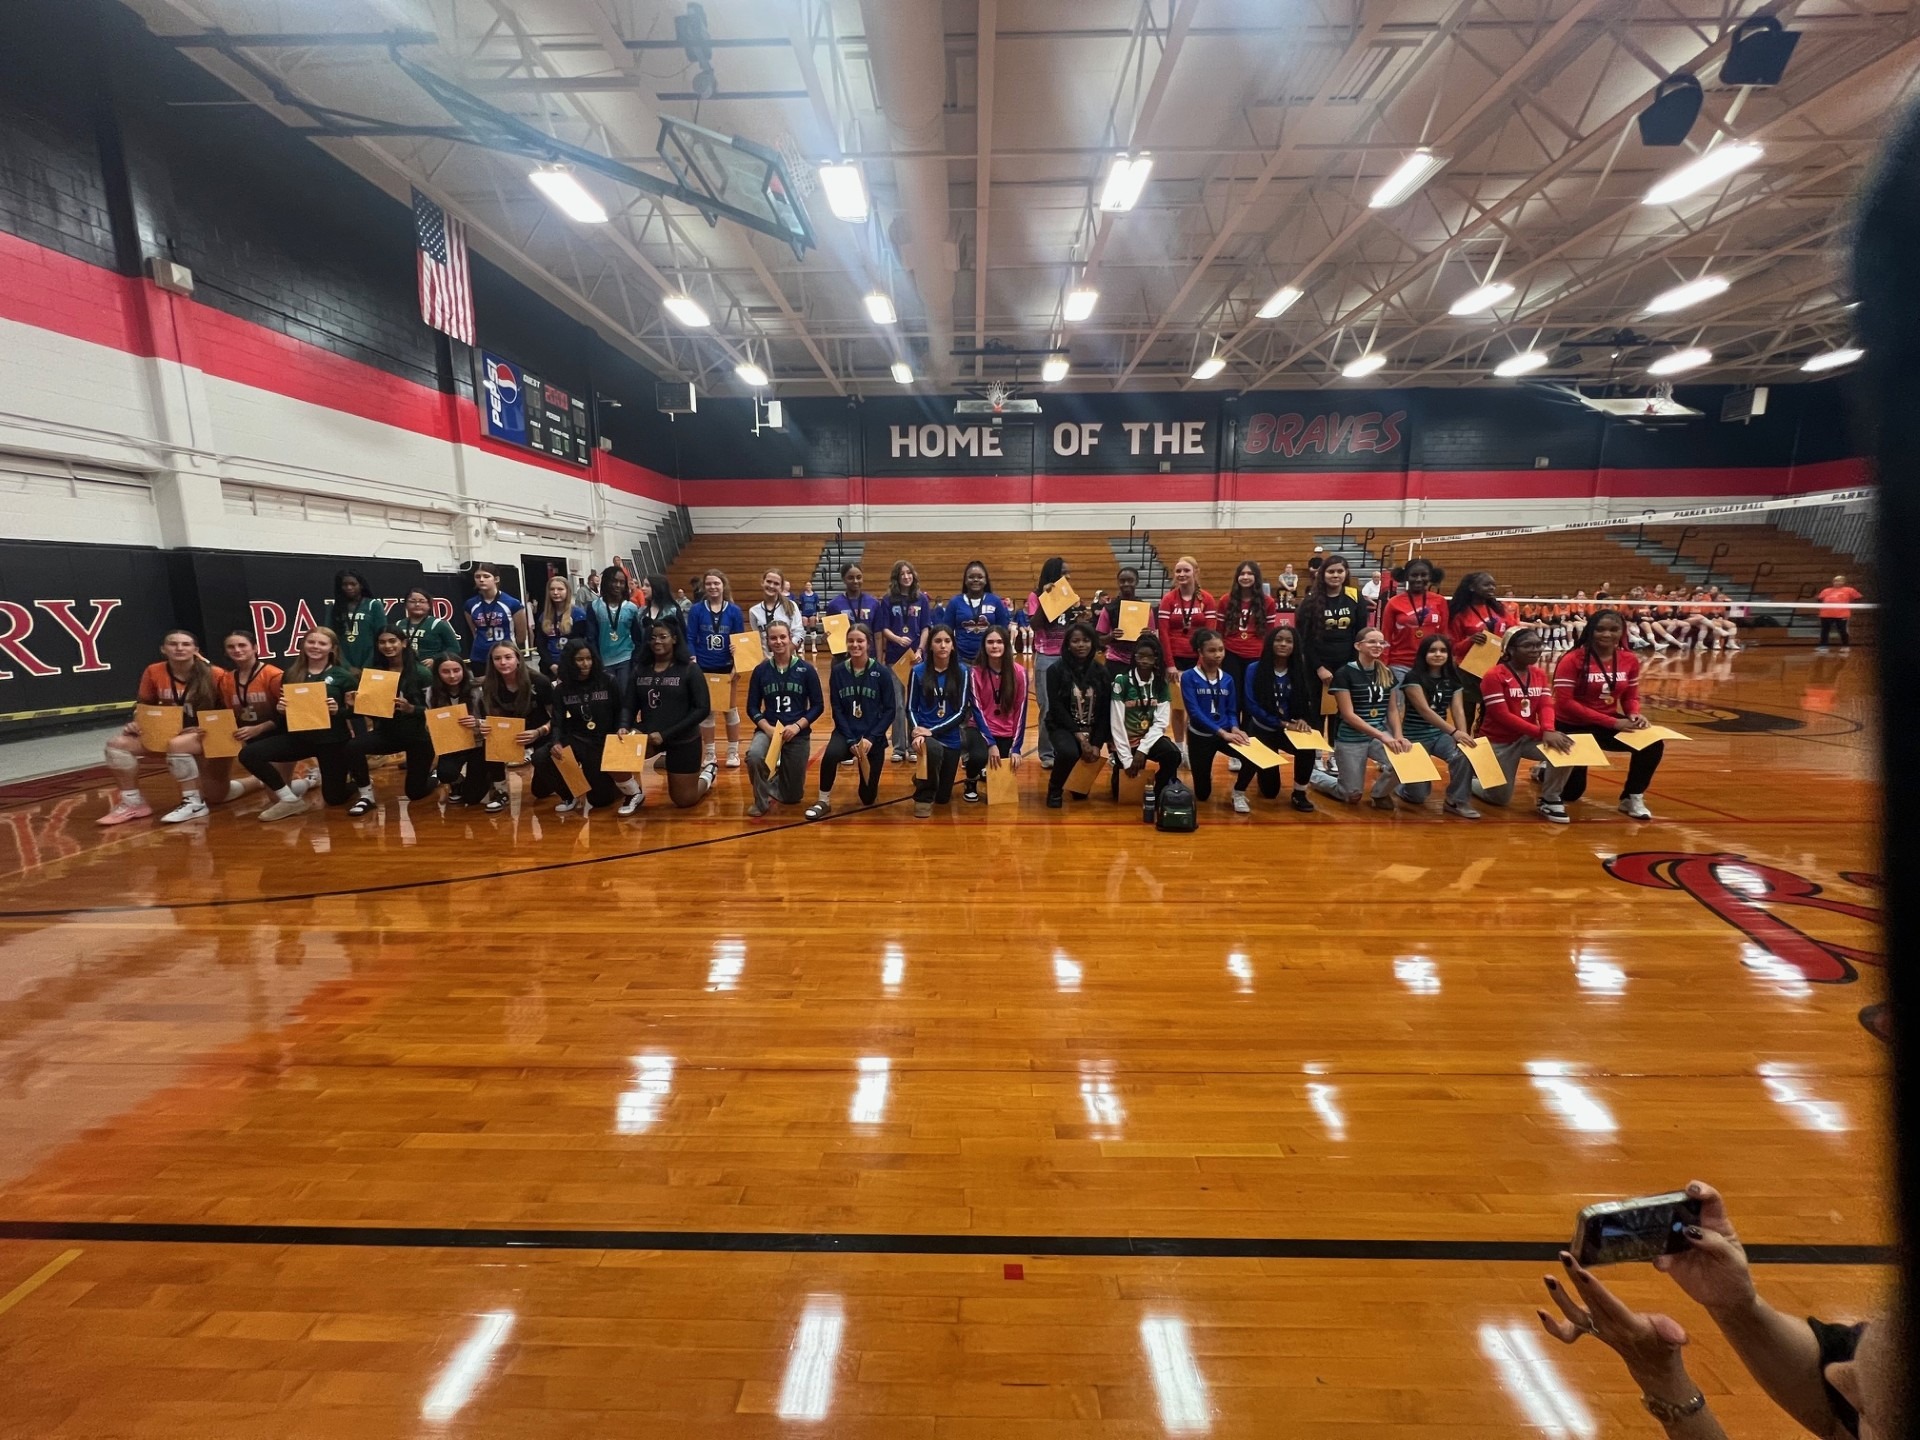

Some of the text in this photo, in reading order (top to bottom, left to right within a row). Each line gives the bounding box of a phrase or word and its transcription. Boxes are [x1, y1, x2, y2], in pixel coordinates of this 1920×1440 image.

[482, 358, 503, 428] PEPSI
[889, 410, 1407, 458] HOME OF THE BRAVES
[1672, 502, 1764, 518] PARKER VOLLEYBALL
[249, 598, 462, 660] PAR
[763, 682, 803, 695] SEAWKS
[775, 695, 791, 713] 12
